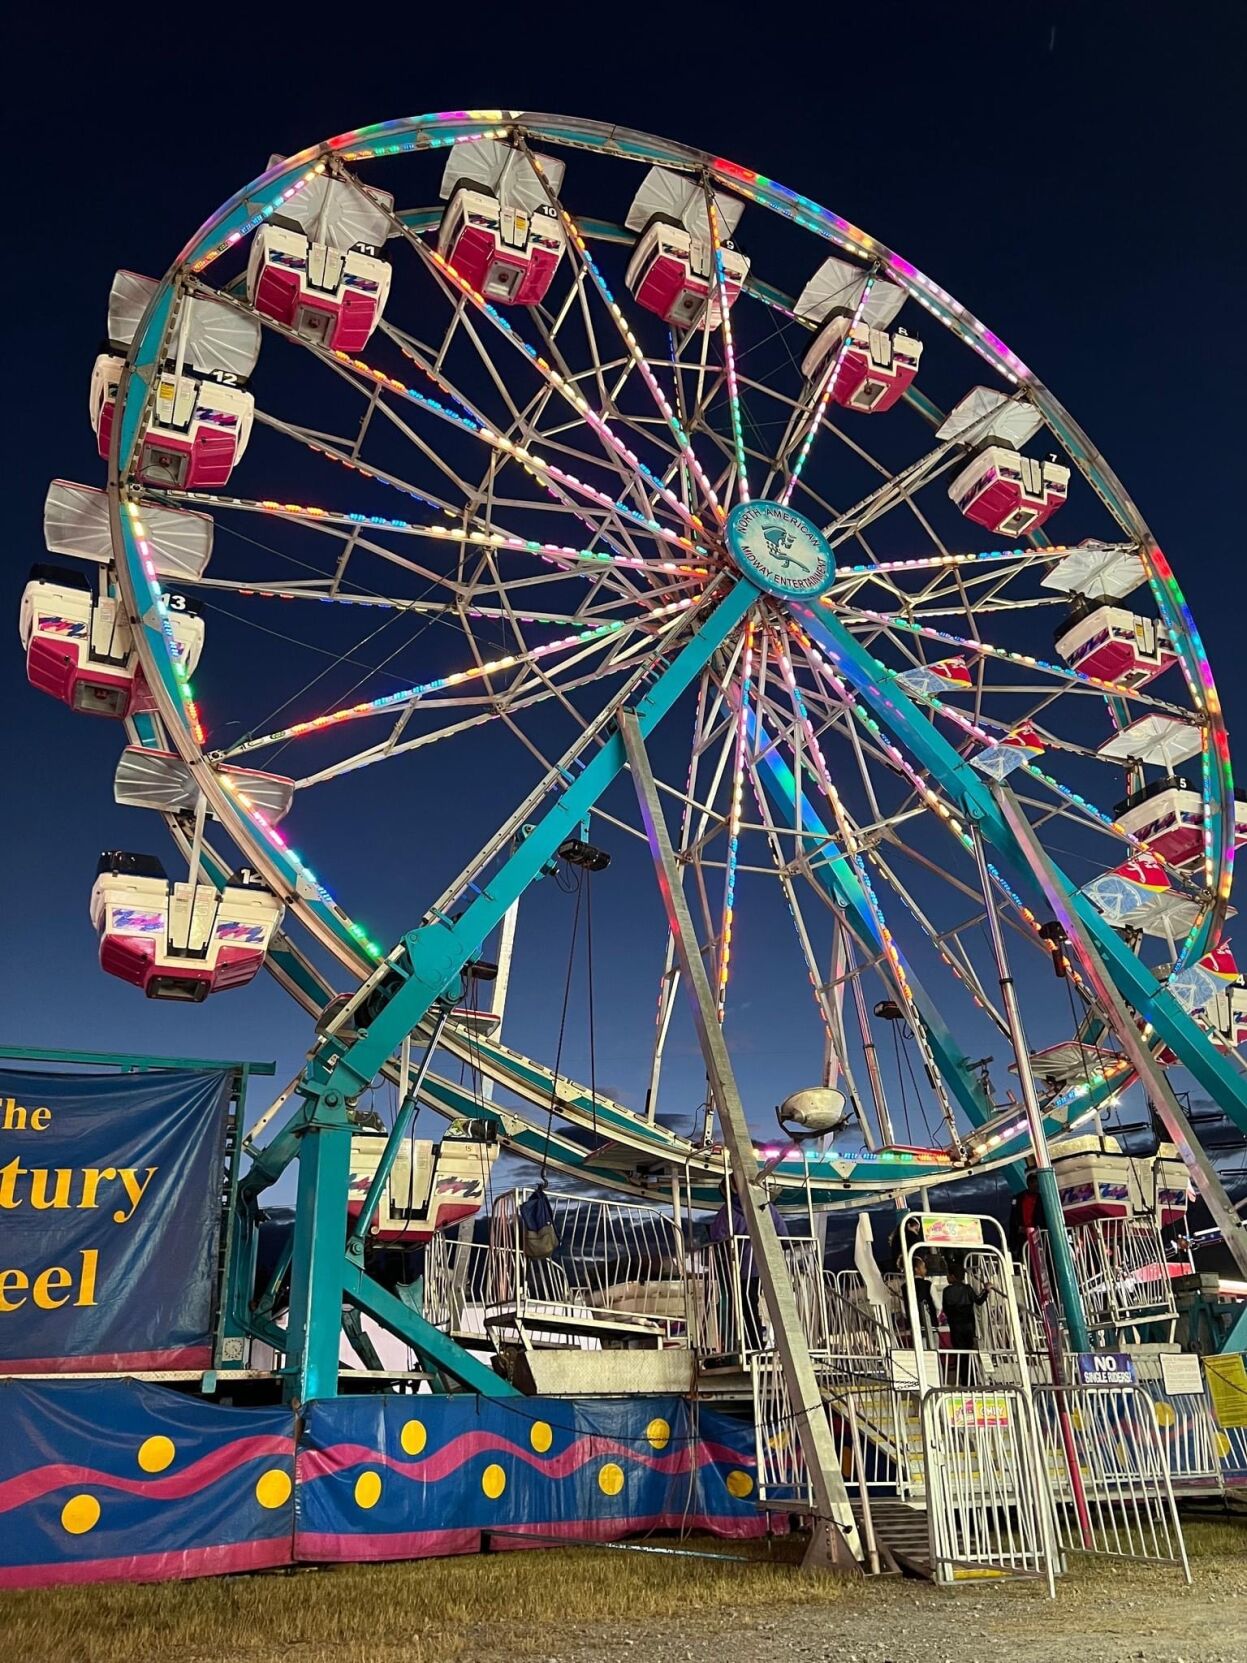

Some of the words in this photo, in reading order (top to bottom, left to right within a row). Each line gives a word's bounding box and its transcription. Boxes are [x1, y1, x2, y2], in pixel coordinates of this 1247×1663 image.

[542, 205, 557, 218] 10
[356, 242, 375, 256] 11
[726, 240, 735, 250] 9
[212, 370, 238, 386] 12
[1049, 453, 1058, 463] 7
[737, 508, 762, 534] NORTH
[765, 508, 820, 547] AMERICAN
[741, 545, 773, 578] MIDWAY
[774, 556, 826, 589] ENTERTAINMENT
[1179, 777, 1187, 788] 5
[0, 1097, 52, 1131] he
[1093, 1355, 1117, 1372] NO
[1083, 1371, 1108, 1384] SINGLE
